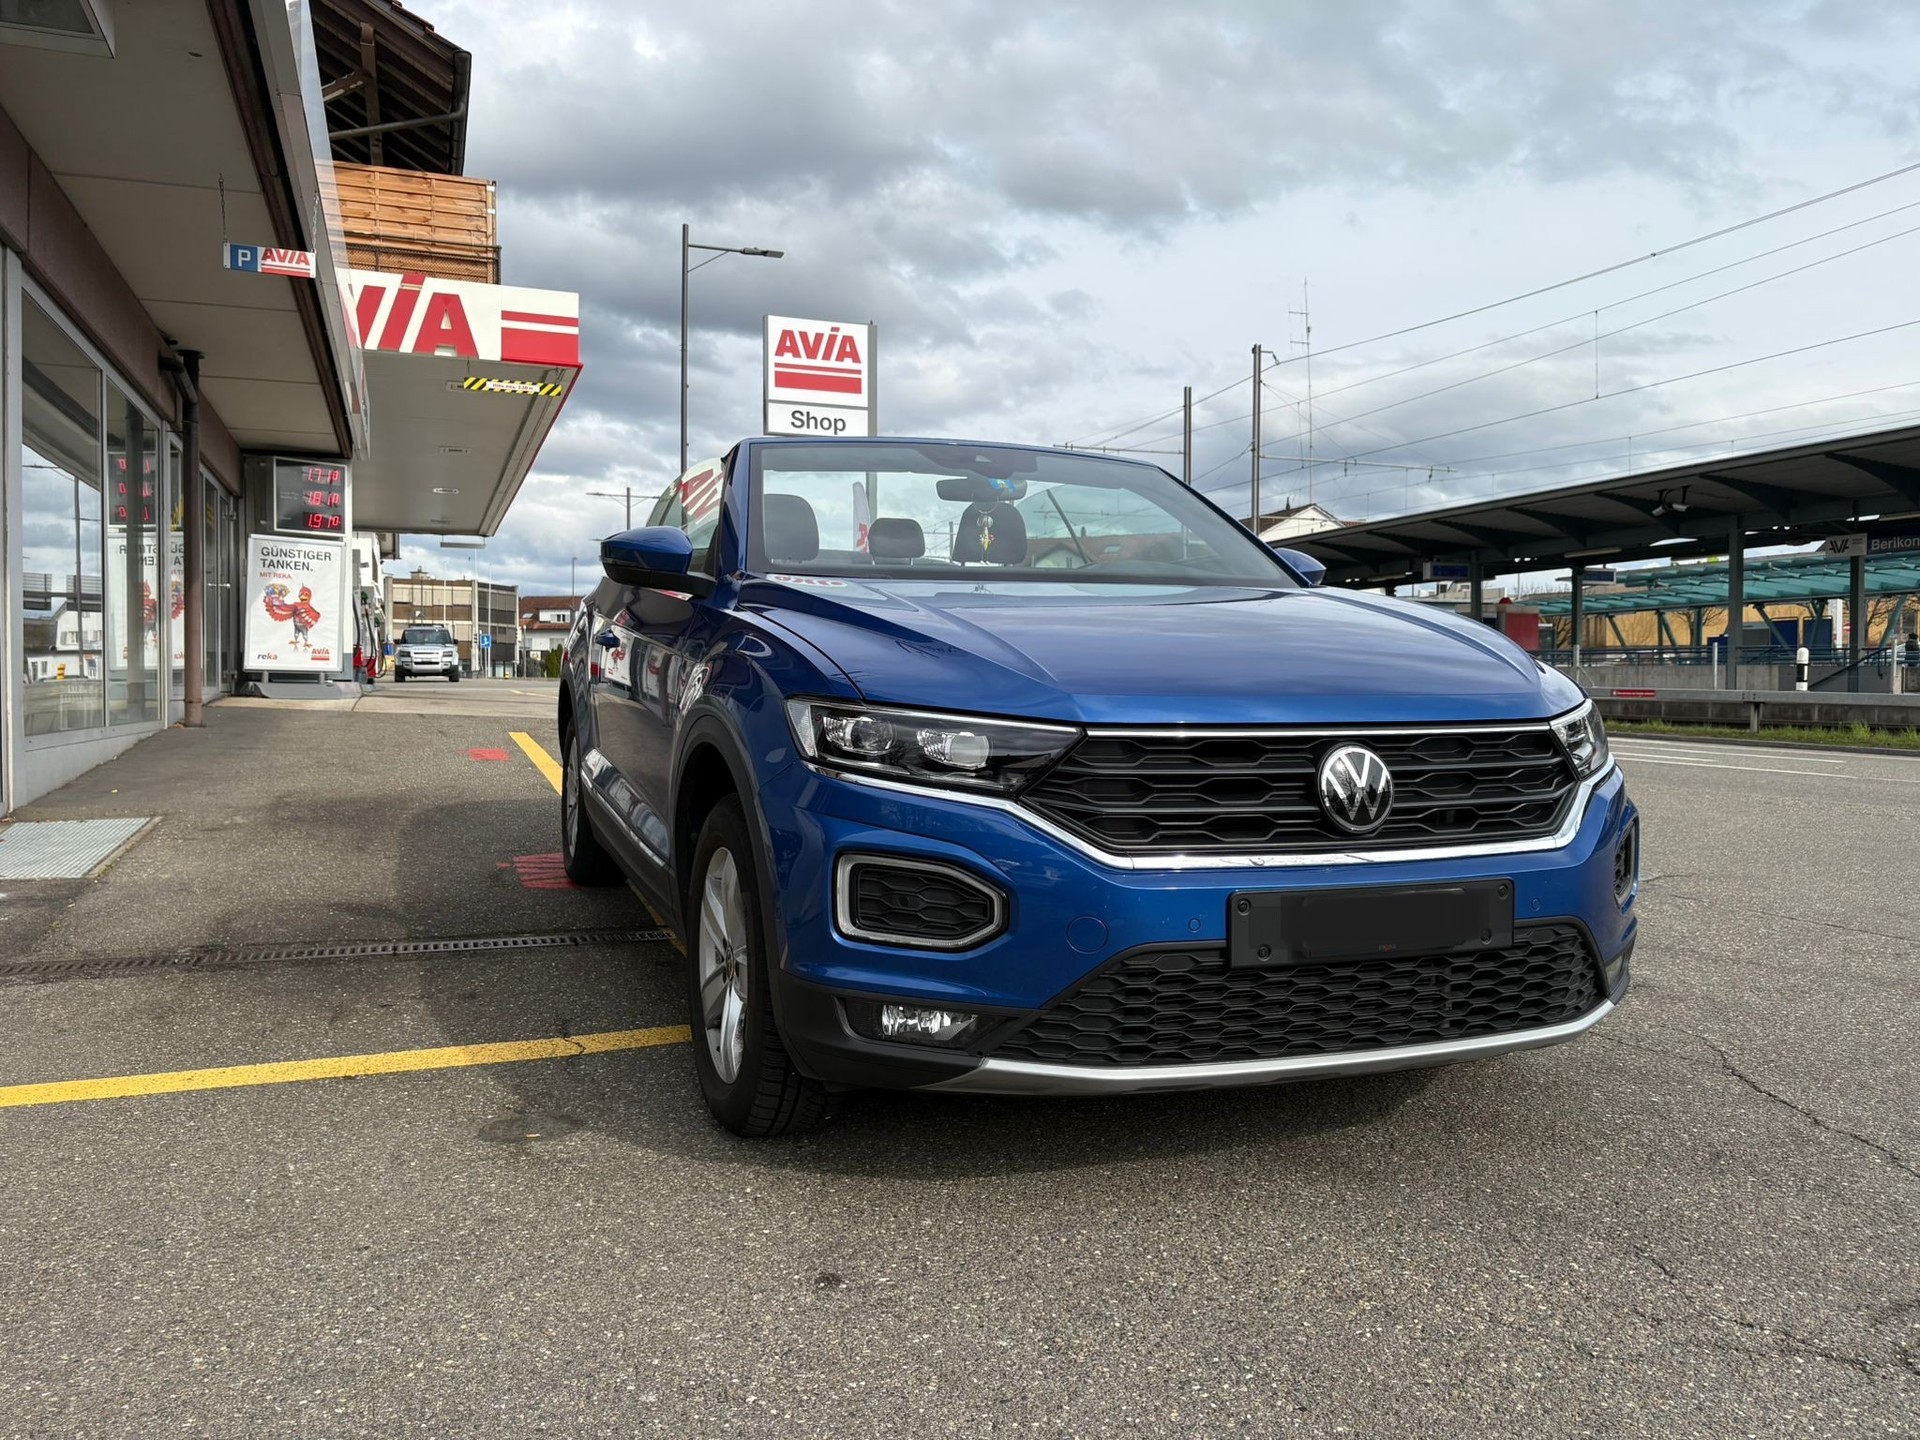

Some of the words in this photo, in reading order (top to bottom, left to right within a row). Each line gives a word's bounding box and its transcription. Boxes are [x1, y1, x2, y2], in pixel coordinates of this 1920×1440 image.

[238, 249, 251, 267] P
[261, 247, 310, 266] AVIA
[774, 326, 862, 364] AVIA
[790, 410, 847, 435] Shop
[261, 545, 332, 561] GÜNSTIGER
[260, 558, 313, 572] TANKEN.
